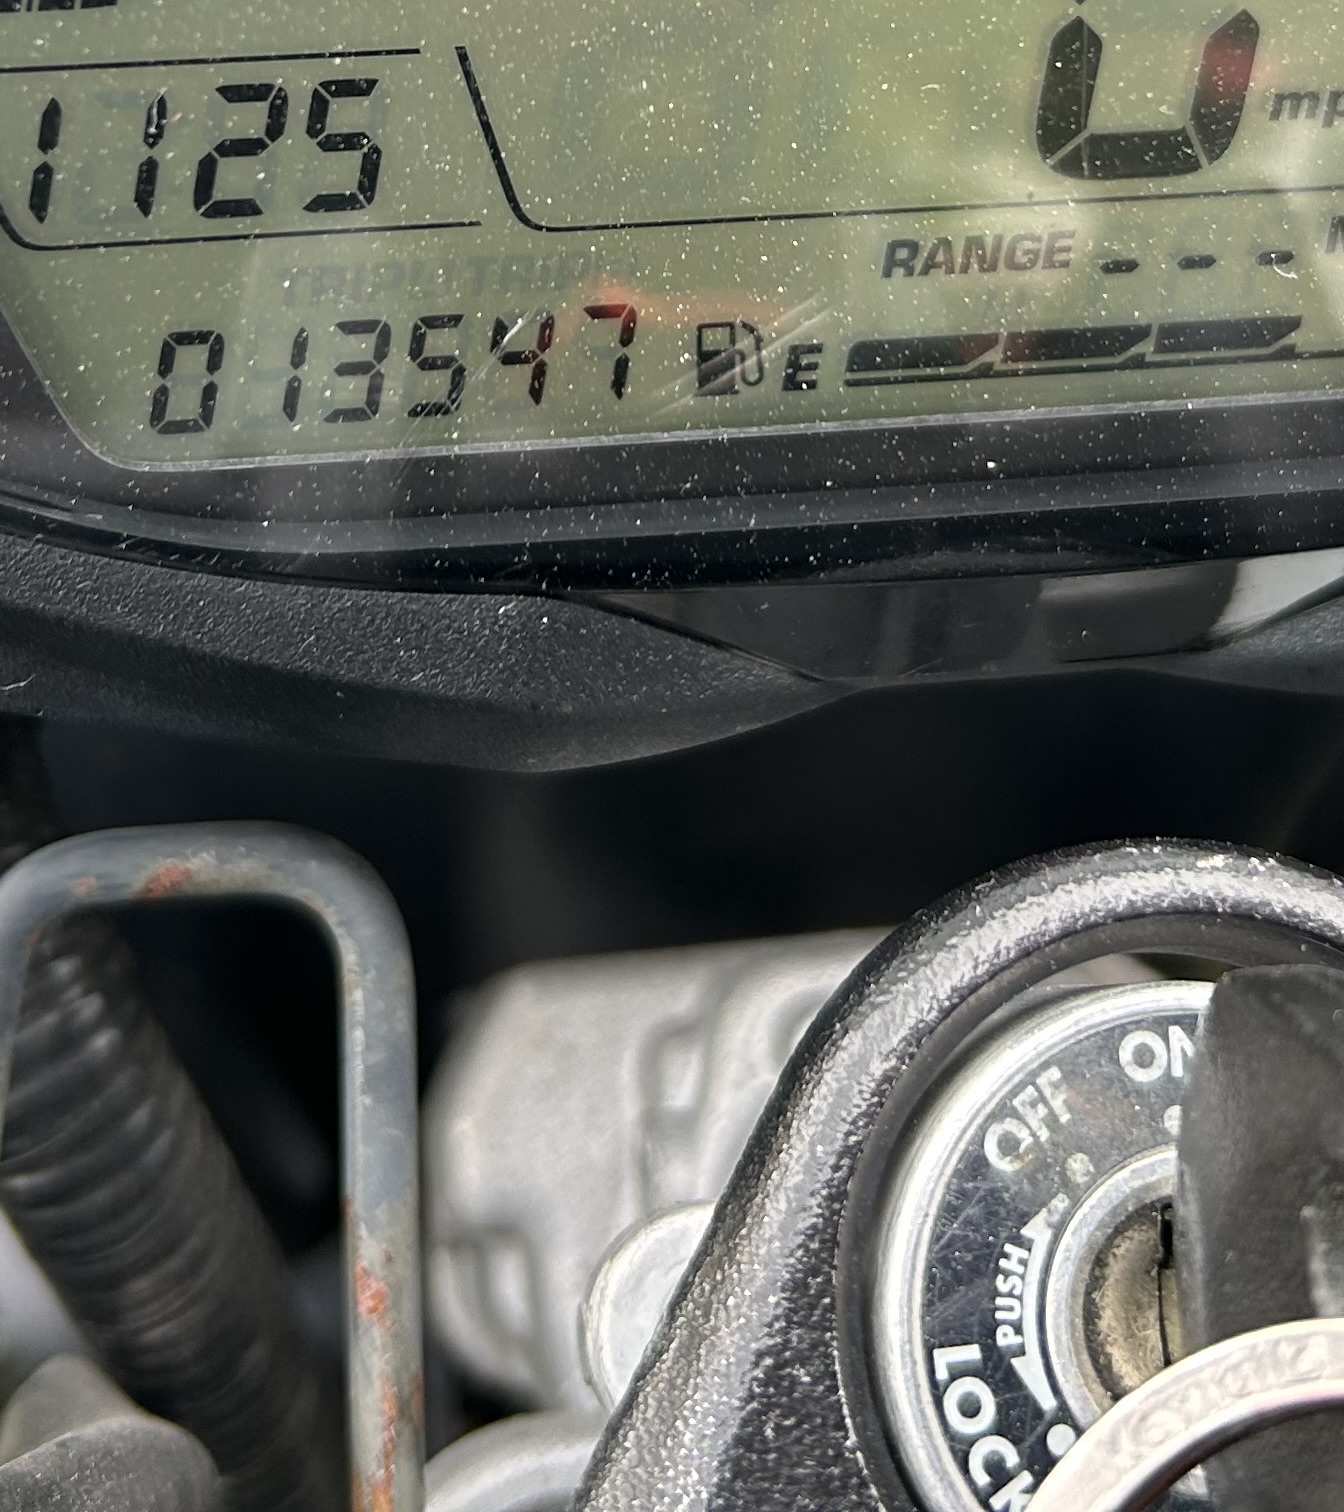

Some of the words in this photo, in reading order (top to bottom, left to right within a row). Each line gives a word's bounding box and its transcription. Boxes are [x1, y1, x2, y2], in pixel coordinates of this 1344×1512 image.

[28, 76, 383, 225] 1125
[881, 228, 1077, 280] RANGE
[149, 303, 639, 436] 013547
[781, 342, 825, 392] E
[982, 1068, 1074, 1173] OFF
[995, 1242, 1031, 1349] PUSH
